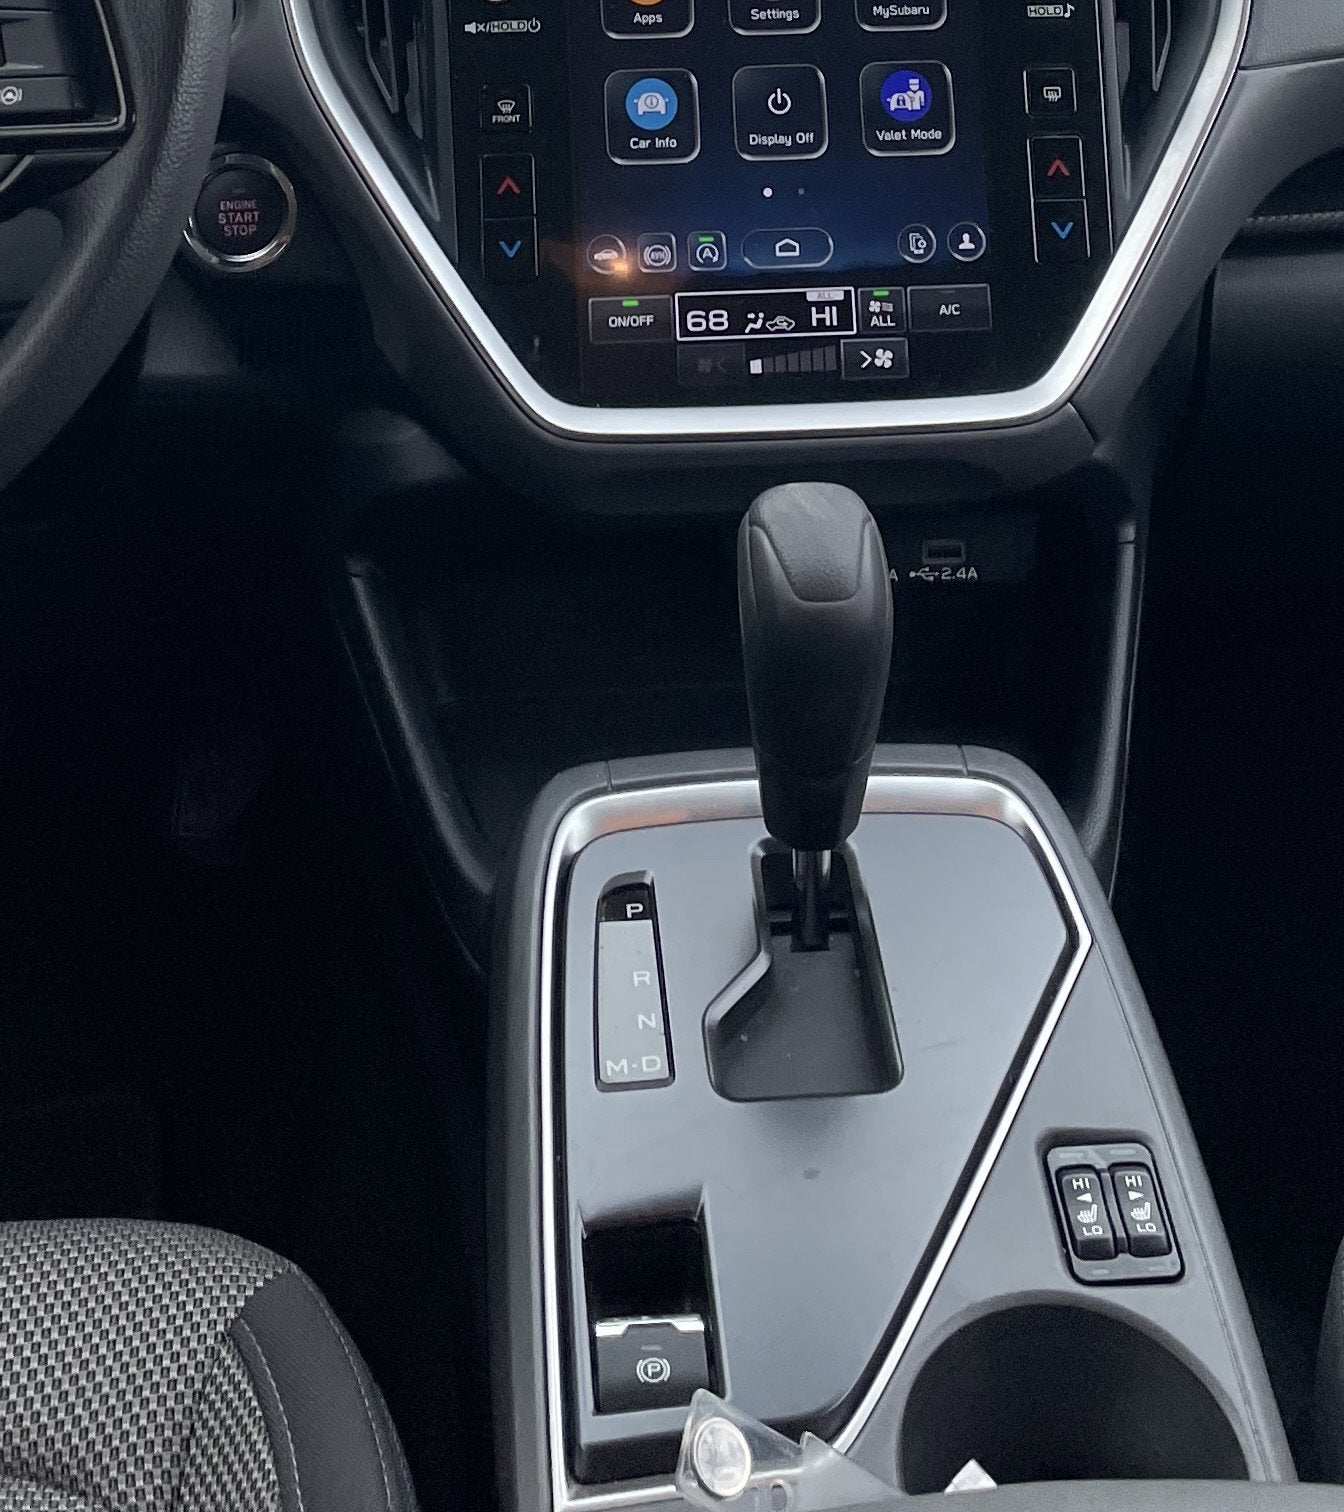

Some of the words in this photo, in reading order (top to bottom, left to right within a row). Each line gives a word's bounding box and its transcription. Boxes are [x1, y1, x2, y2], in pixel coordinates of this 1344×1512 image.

[750, 8, 800, 21] Settings
[872, 5, 930, 19] MySubaru
[1028, 6, 1063, 16] HOLD
[633, 12, 663, 25] Apps
[492, 114, 520, 123] FRONT
[749, 133, 792, 147] Display
[796, 132, 814, 144] Off
[876, 129, 907, 141] Valet
[911, 128, 942, 140] Mode
[629, 138, 651, 149] Car
[655, 137, 677, 148] Info
[219, 199, 258, 211] ENGINE
[218, 211, 260, 225] START
[223, 224, 257, 237] STOP
[811, 306, 838, 327] HI
[939, 304, 961, 316] A/C
[608, 315, 654, 329] ON/OFF
[686, 309, 730, 332] 68
[869, 316, 896, 328] ALL
[941, 567, 978, 581] 2.4A
[625, 903, 643, 919] P
[632, 970, 651, 987] R
[637, 1013, 656, 1030] N
[1072, 1177, 1090, 1189] HI
[1125, 1175, 1143, 1187] HI
[1082, 1225, 1103, 1236] LO
[1136, 1222, 1156, 1232] LO
